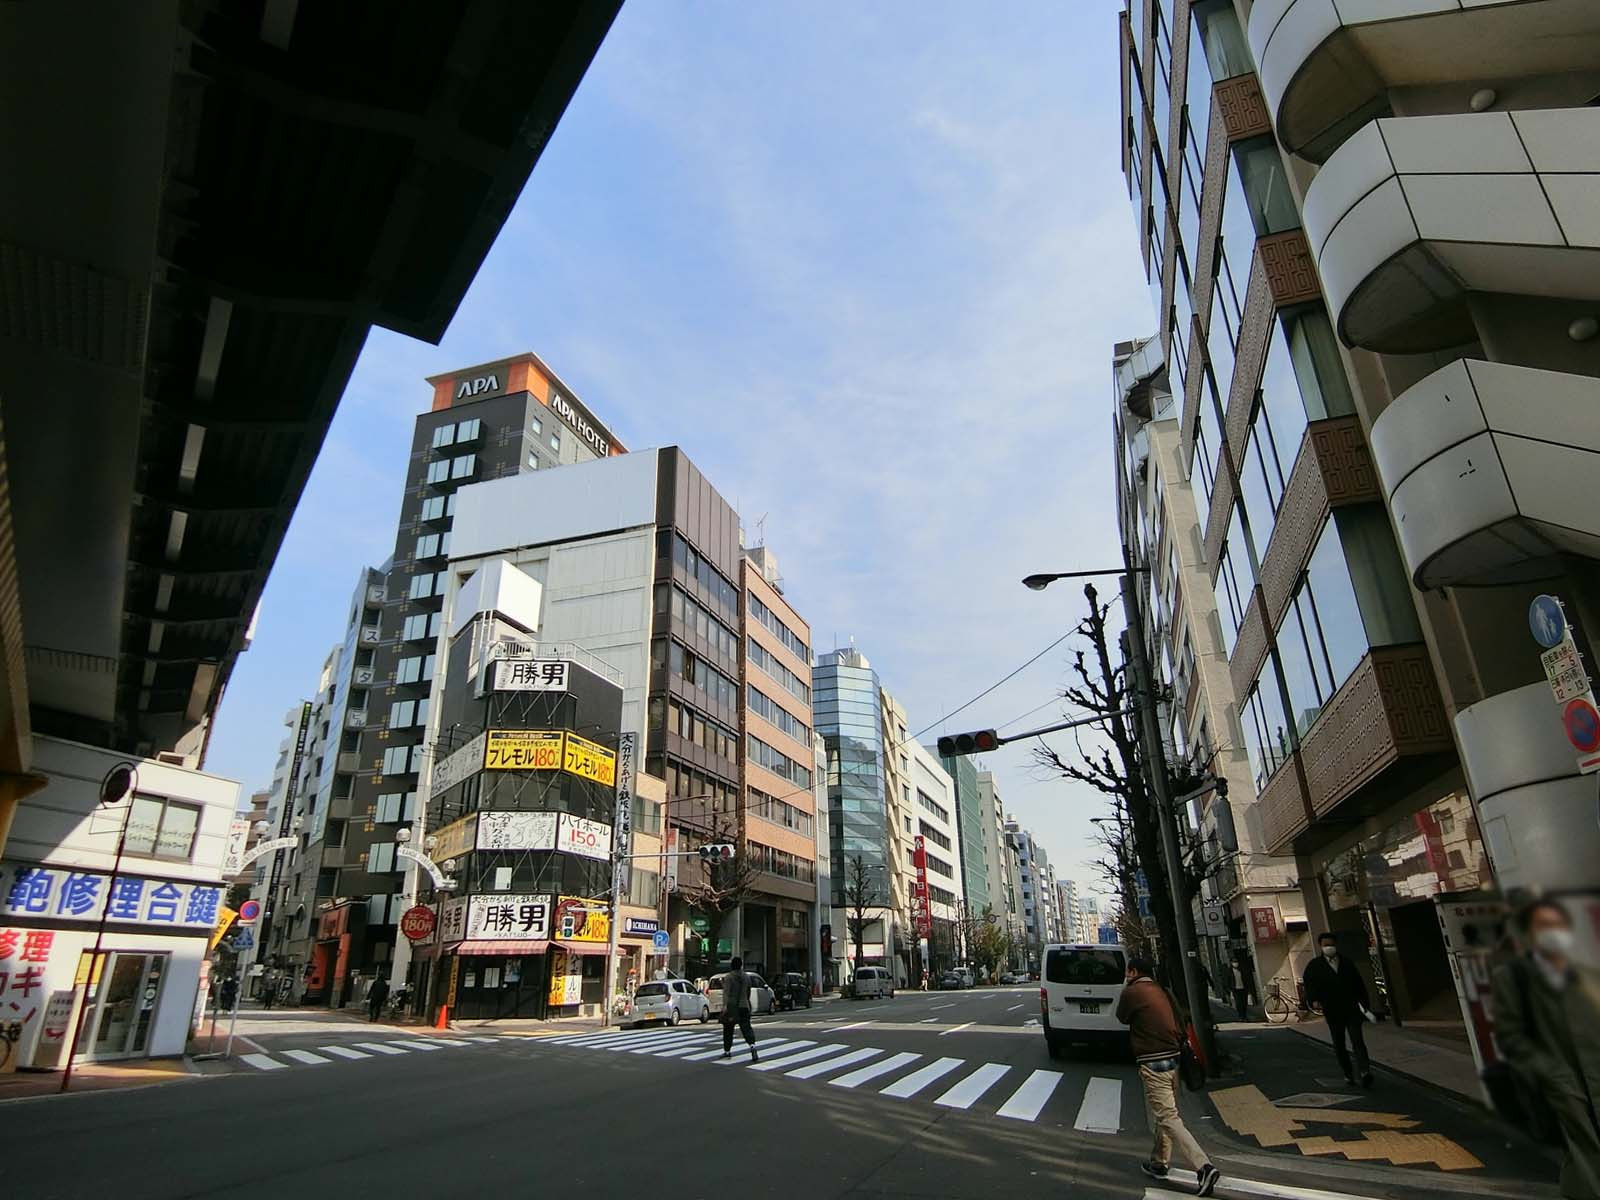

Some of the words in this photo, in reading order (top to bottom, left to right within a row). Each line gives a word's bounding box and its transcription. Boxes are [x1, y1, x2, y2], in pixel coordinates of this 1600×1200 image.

[457, 375, 499, 399] APA
[552, 394, 576, 427] APA
[510, 662, 565, 686] 勝男
[6, 866, 220, 925] 鞄修理合鍵
[483, 904, 546, 932] 勝男
